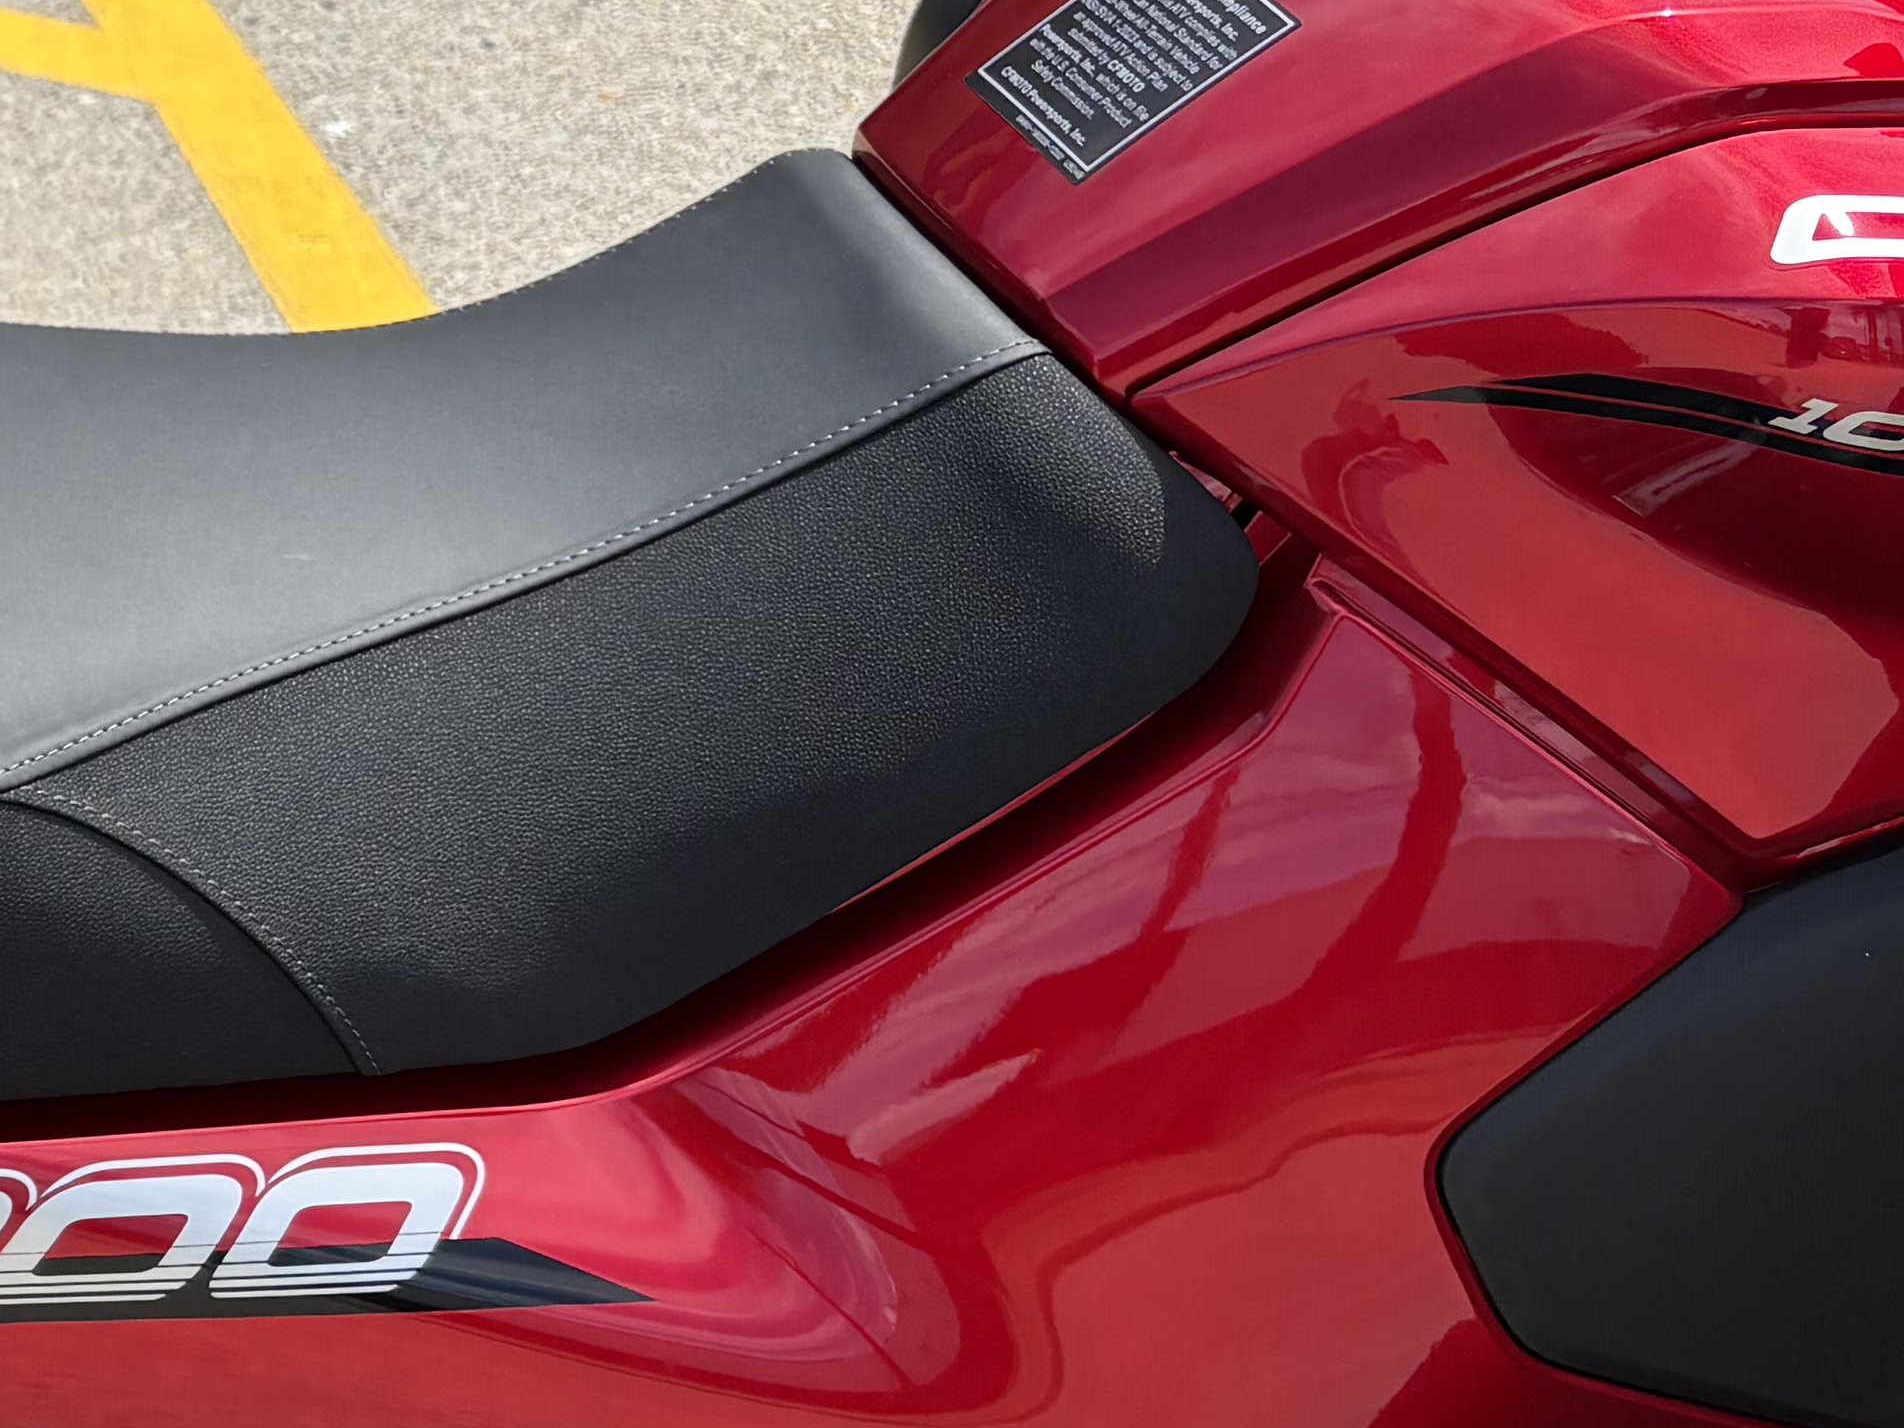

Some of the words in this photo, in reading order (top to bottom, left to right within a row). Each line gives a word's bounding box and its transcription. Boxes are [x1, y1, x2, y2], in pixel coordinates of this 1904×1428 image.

[1143, 3, 1181, 33] National
[1171, 26, 1215, 62] Standard
[1205, 55, 1225, 71] for
[1167, 2, 1192, 19] ATV
[1181, 14, 1223, 48] complies
[1215, 41, 1239, 61] with
[1219, 22, 1242, 42] Inc.
[1132, 38, 1154, 55] and
[1145, 48, 1160, 62] is
[1167, 44, 1202, 75] Vehicle
[1028, 58, 1057, 84] Safety
[1105, 58, 1147, 93] CFMOTO
[1108, 39, 1132, 57] ATV
[1122, 50, 1152, 77] Action
[1145, 70, 1170, 92] Plan
[1151, 56, 1188, 85] subject
[1094, 71, 1122, 95] which
[1114, 88, 1129, 102] is
[1179, 78, 1195, 92] to
[999, 65, 1033, 94] CFMOTO
[1068, 127, 1089, 147] Inc.
[1096, 96, 1134, 128] Product
[1121, 97, 1138, 111] on
